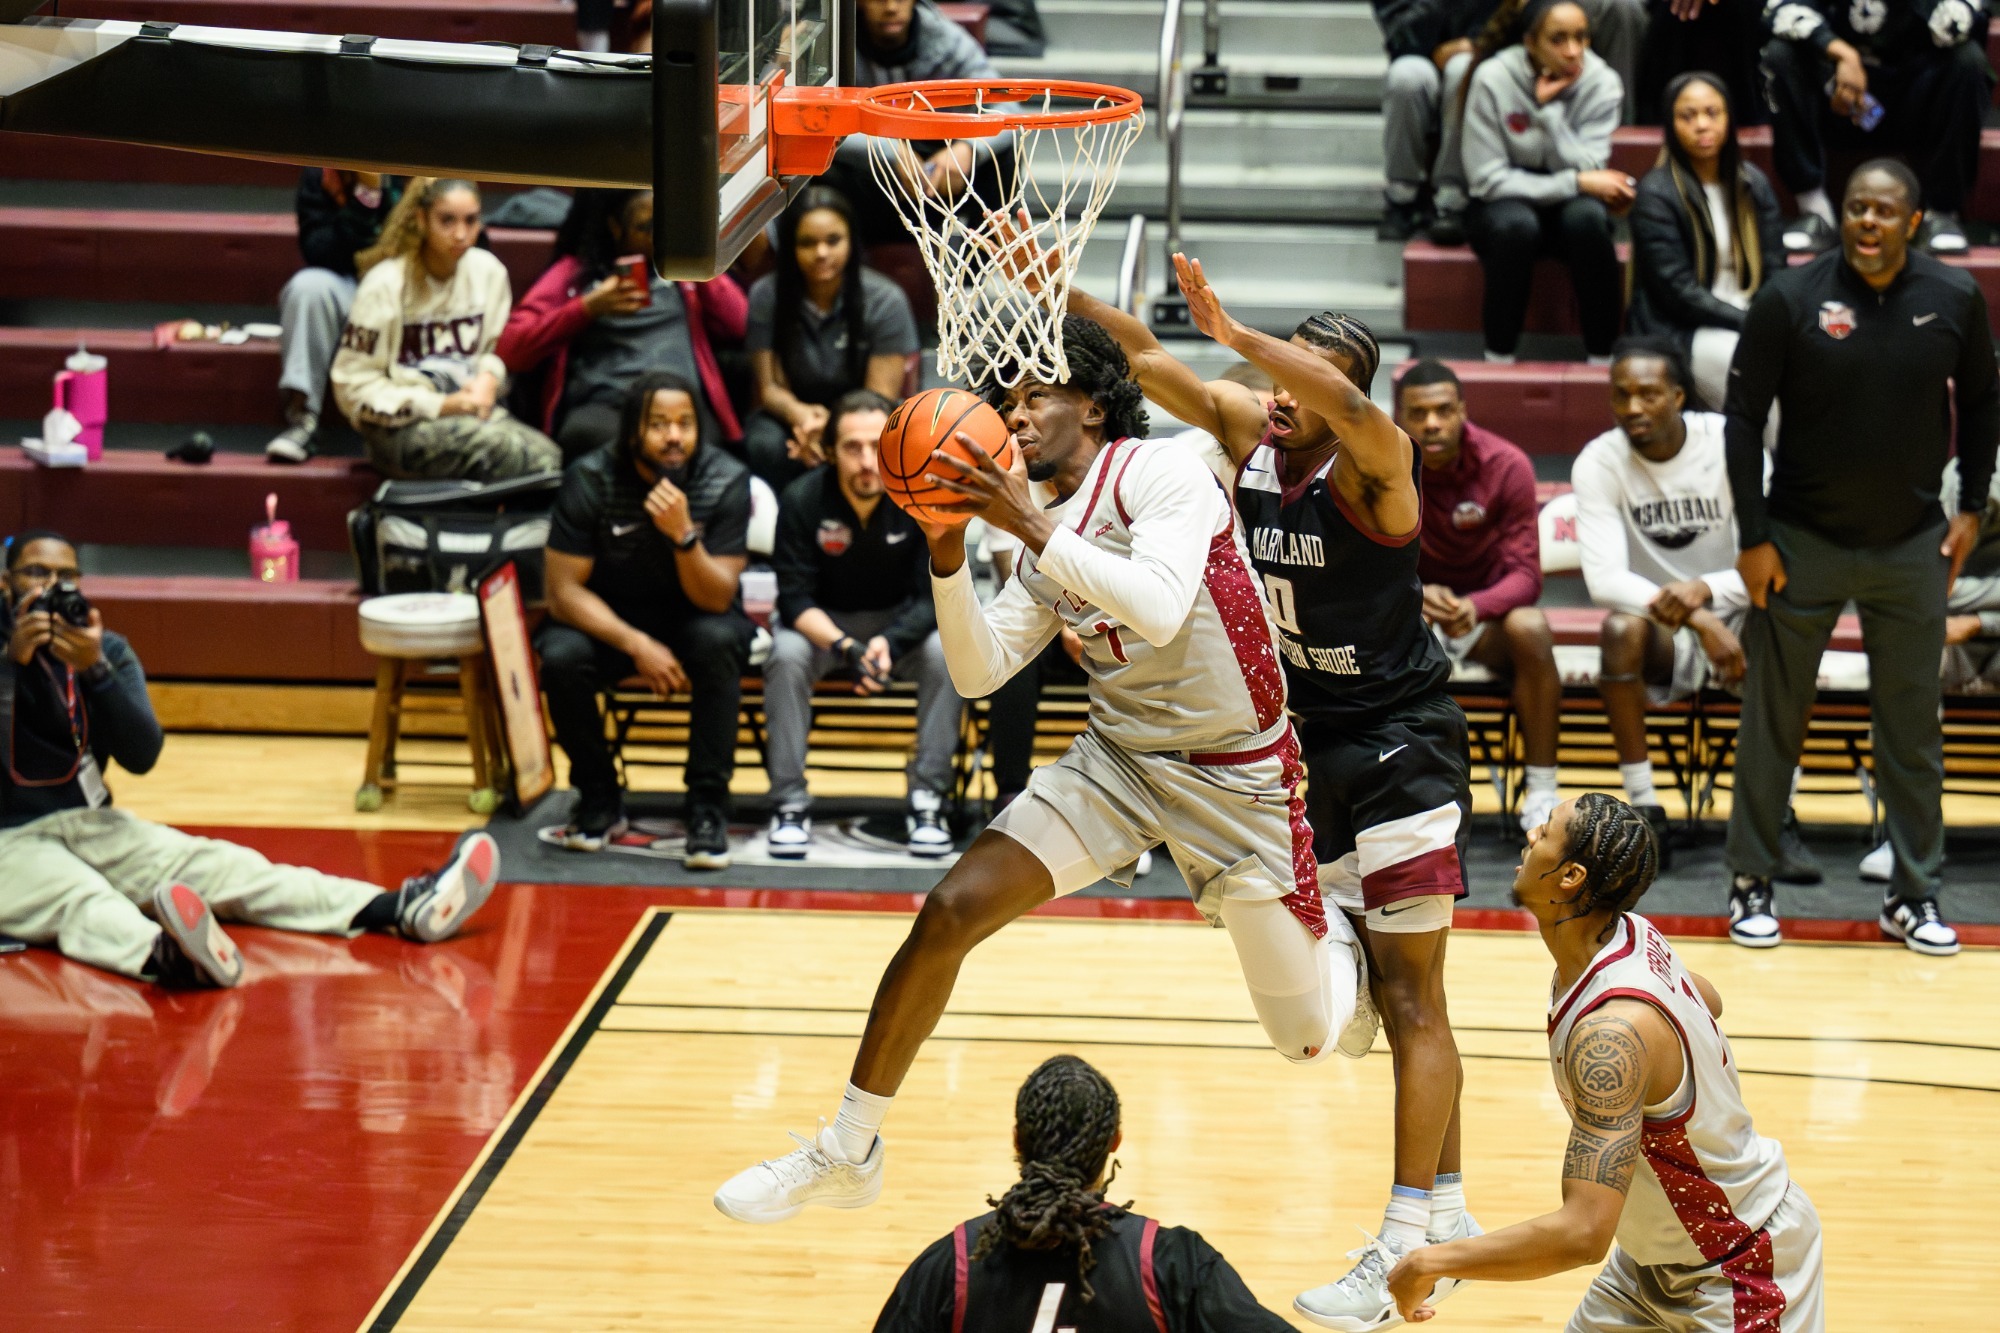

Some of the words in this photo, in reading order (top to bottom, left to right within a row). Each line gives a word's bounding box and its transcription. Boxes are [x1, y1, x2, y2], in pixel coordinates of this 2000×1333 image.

[397, 313, 484, 366] NCC
[1252, 527, 1325, 568] MARYLAND
[1264, 573, 1303, 634] 0
[1092, 620, 1130, 665] 1
[1307, 645, 1361, 675] SHORE
